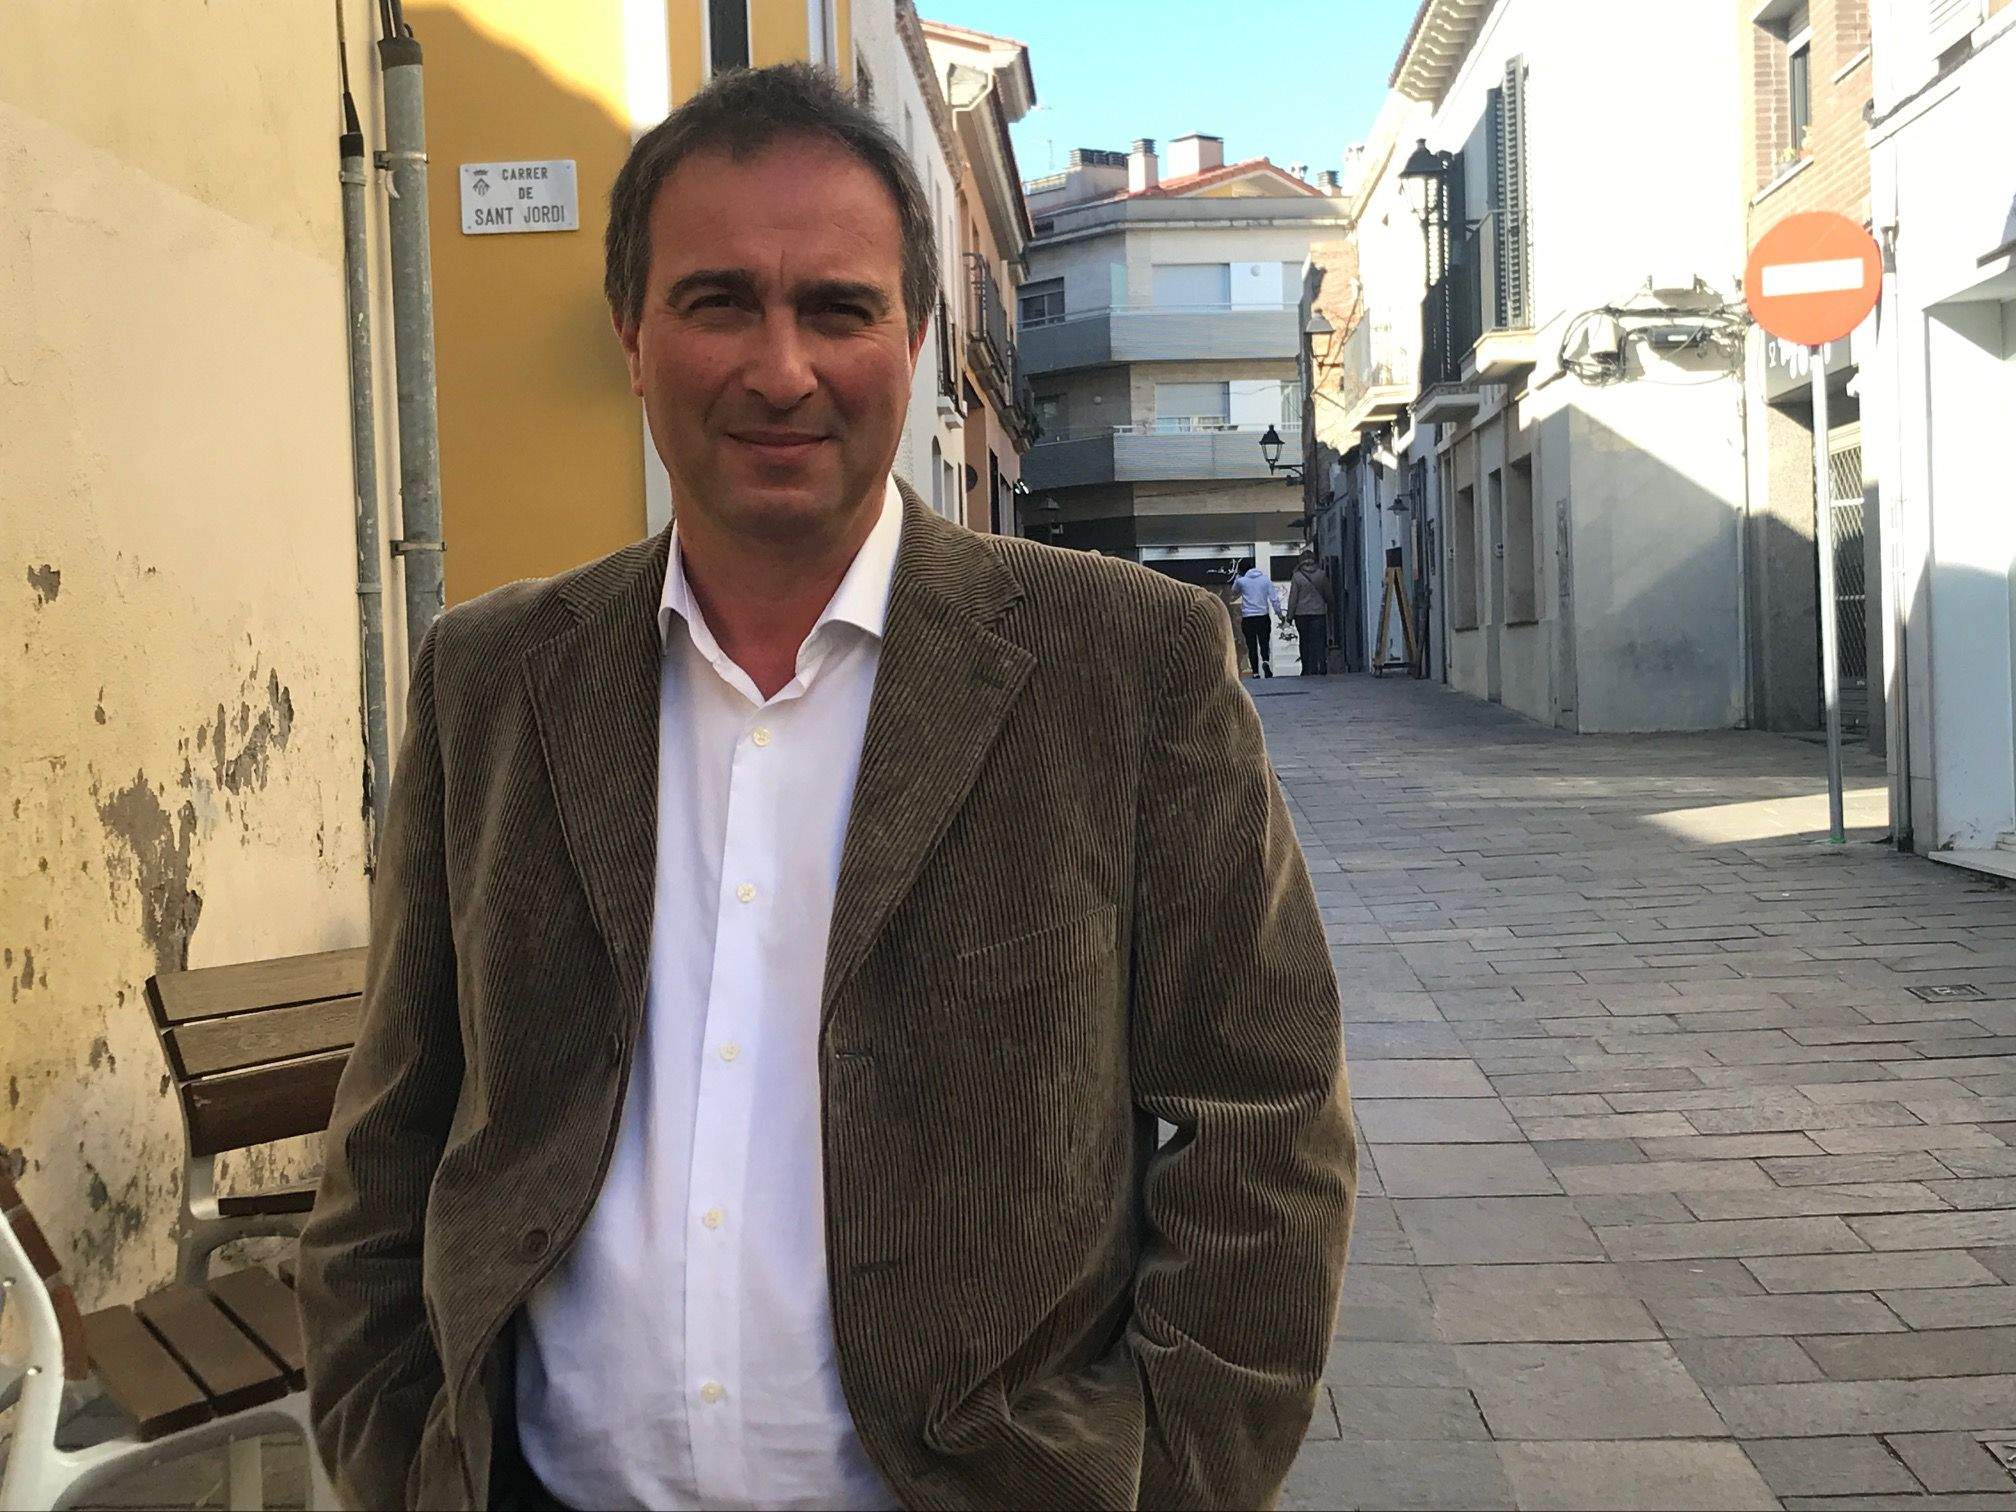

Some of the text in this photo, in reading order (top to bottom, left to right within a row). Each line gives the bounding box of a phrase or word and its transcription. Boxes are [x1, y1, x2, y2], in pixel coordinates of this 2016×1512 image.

[502, 167, 548, 181] CARRER
[518, 187, 534, 199] DE
[474, 205, 565, 226] SANT JORDI
